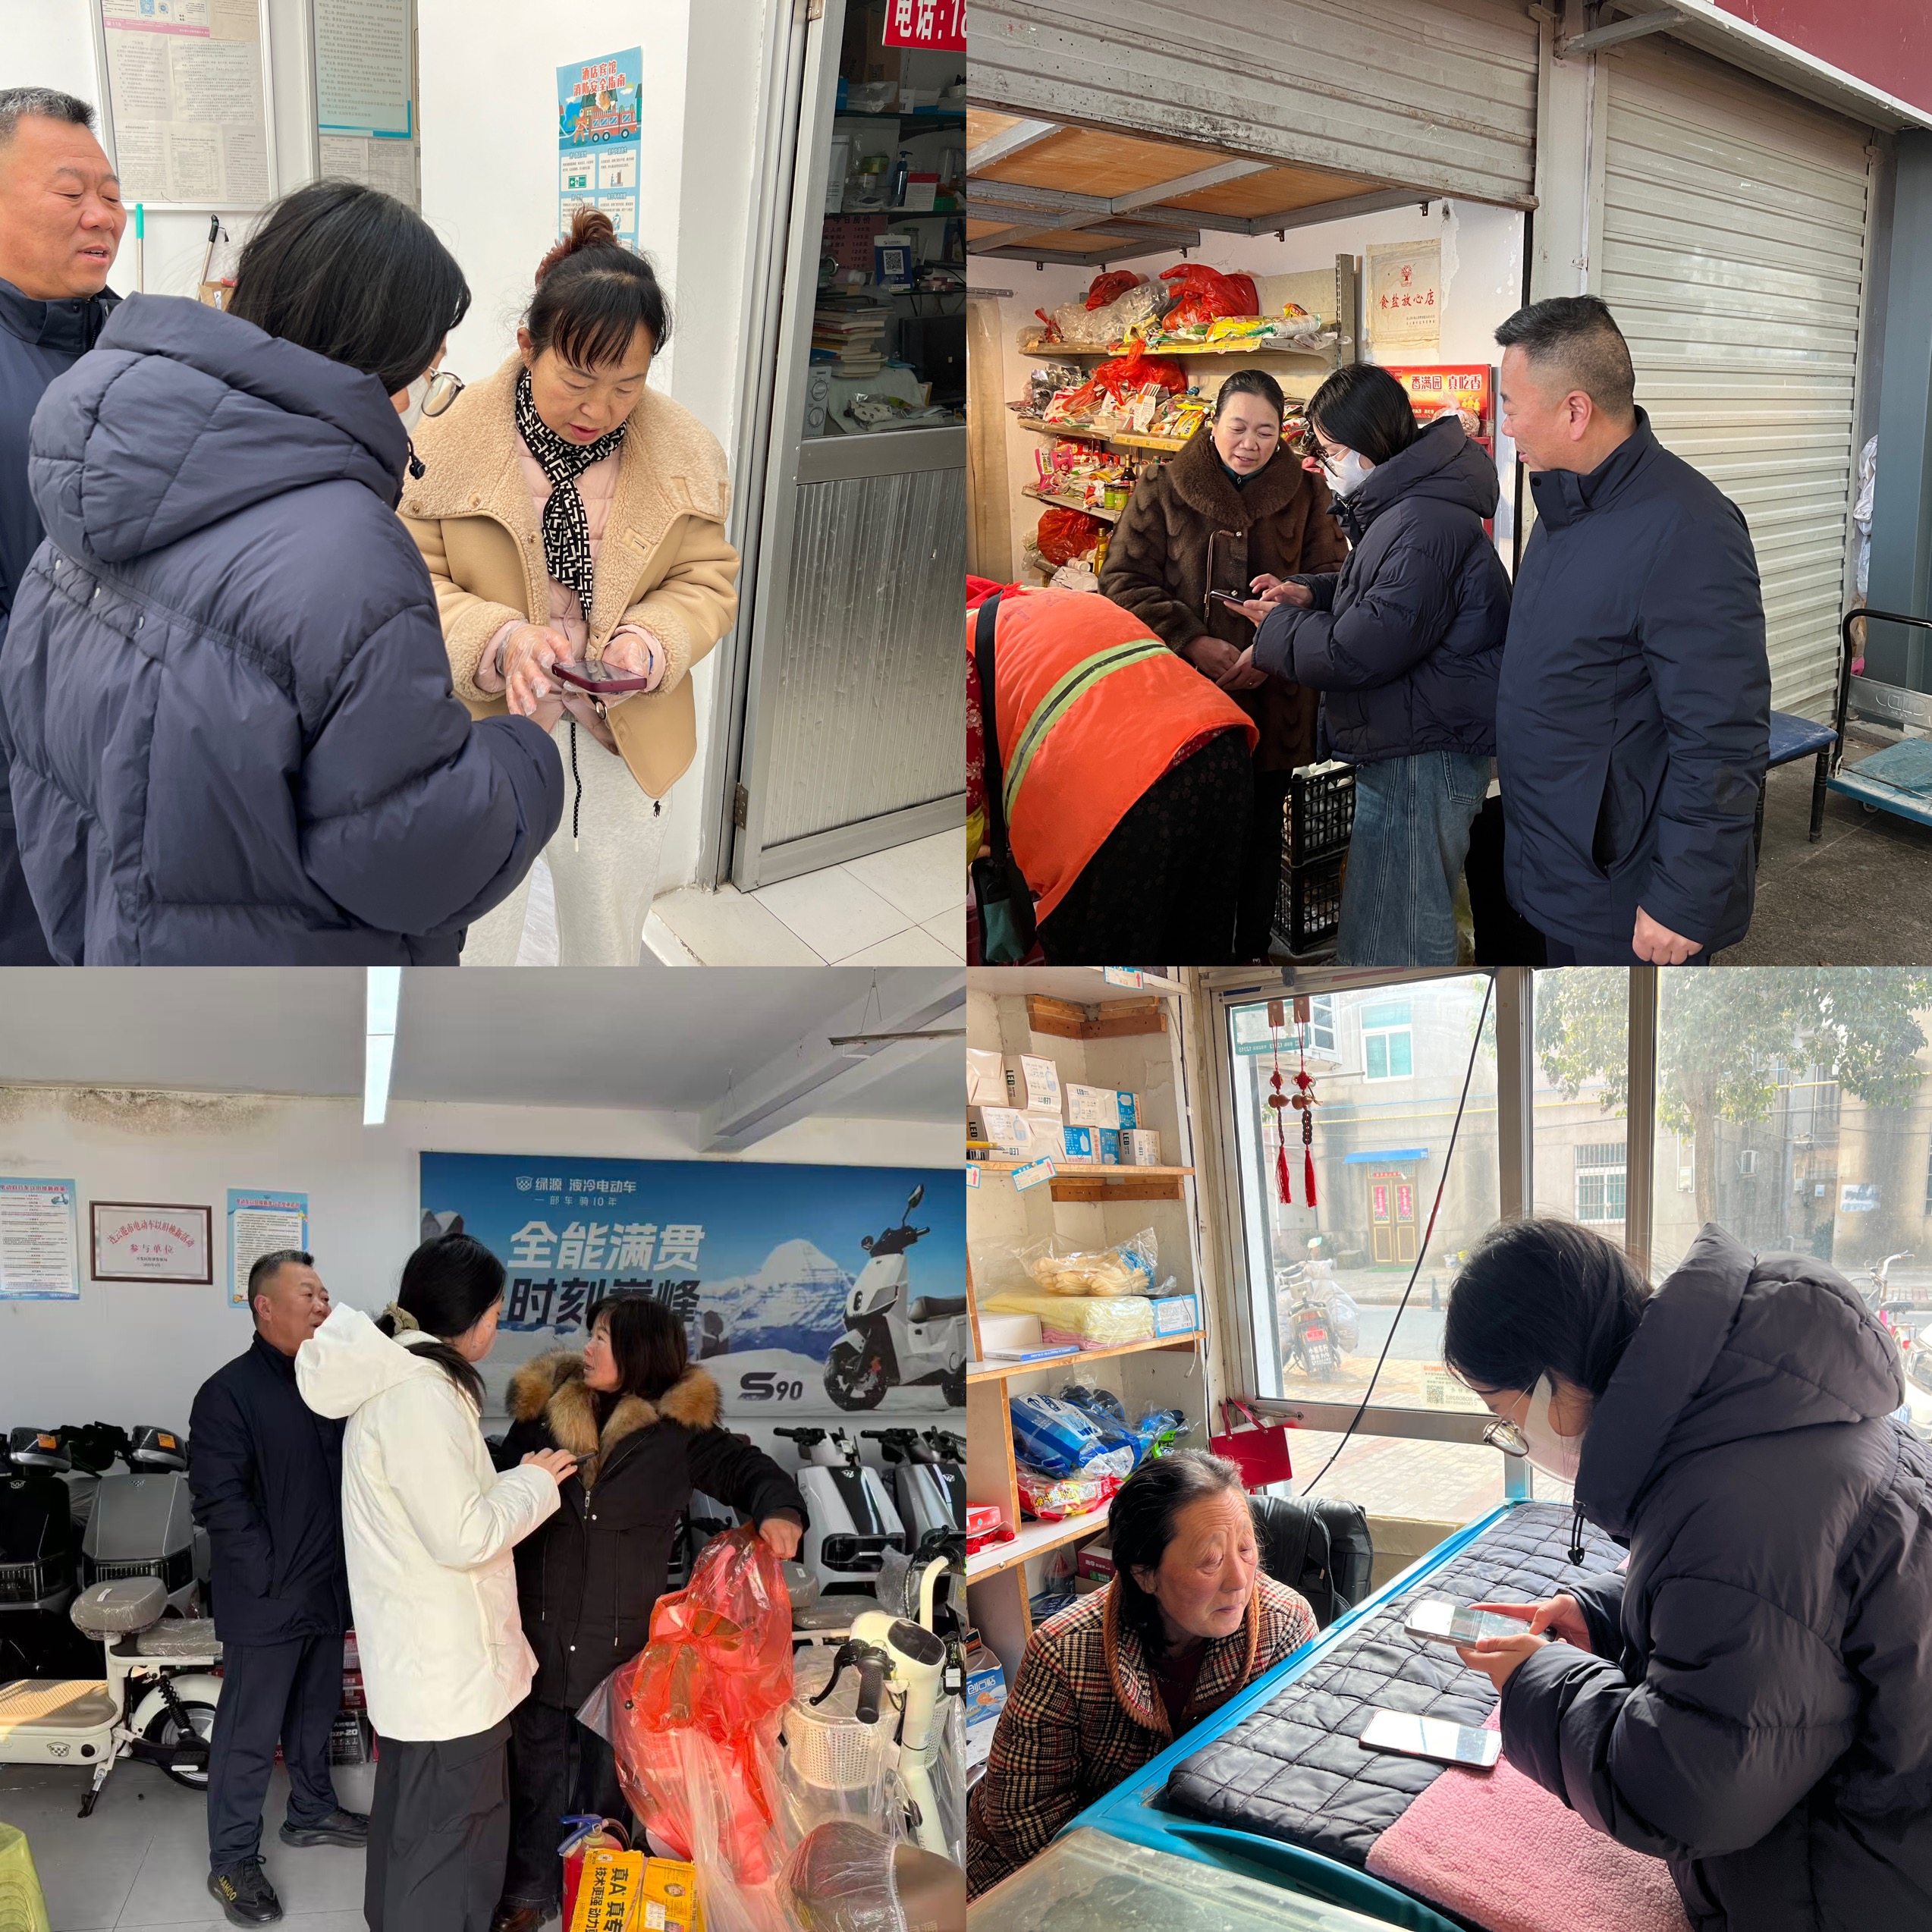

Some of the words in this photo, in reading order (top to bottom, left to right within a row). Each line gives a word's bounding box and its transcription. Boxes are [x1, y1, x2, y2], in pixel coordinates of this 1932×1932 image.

[582, 60, 617, 80] 酒店宾馆
[573, 74, 626, 96] 消防安全指南
[834, 215, 872, 225] 今日房价
[1379, 289, 1435, 309] 食盐放心店
[1412, 375, 1442, 391] 香满园
[1447, 375, 1481, 391] 真吃香
[1006, 1070, 1016, 1085] LED
[969, 1121, 979, 1138] LED
[536, 1177, 562, 1191] 绿源
[570, 1178, 636, 1193] 液冷电动车
[108, 1220, 195, 1248] 连云港市电动车以旧换新活动
[130, 1243, 174, 1255] 参与单位
[507, 1220, 705, 1272] 全能满贯
[738, 1371, 803, 1402] S90
[967, 1679, 996, 1695] 创口贴
[590, 1867, 608, 1907] 技术更强
